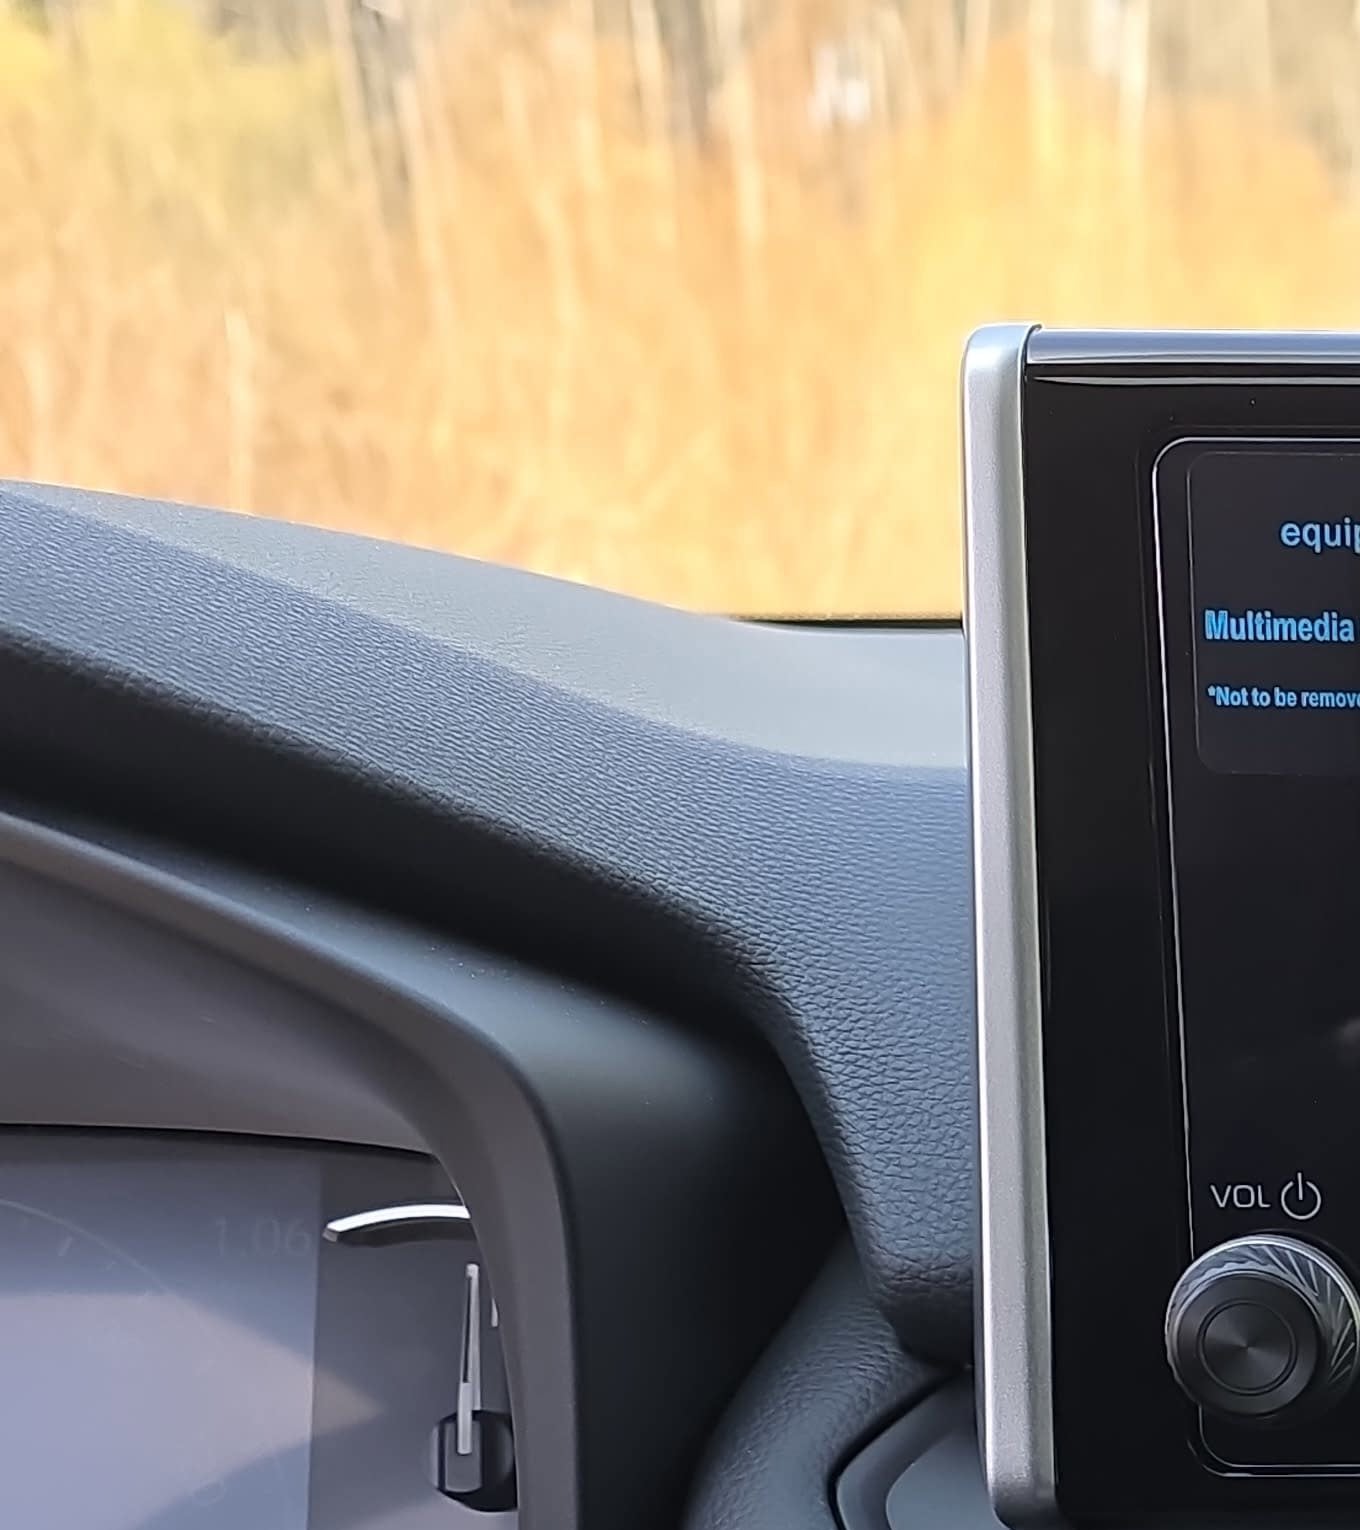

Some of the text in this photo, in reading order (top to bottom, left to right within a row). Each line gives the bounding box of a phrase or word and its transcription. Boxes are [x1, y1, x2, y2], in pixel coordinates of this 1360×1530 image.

[1205, 609, 1355, 643] Multimedia
[1251, 688, 1271, 707] to
[1274, 687, 1297, 707] be
[1210, 1183, 1271, 1210] VOL
